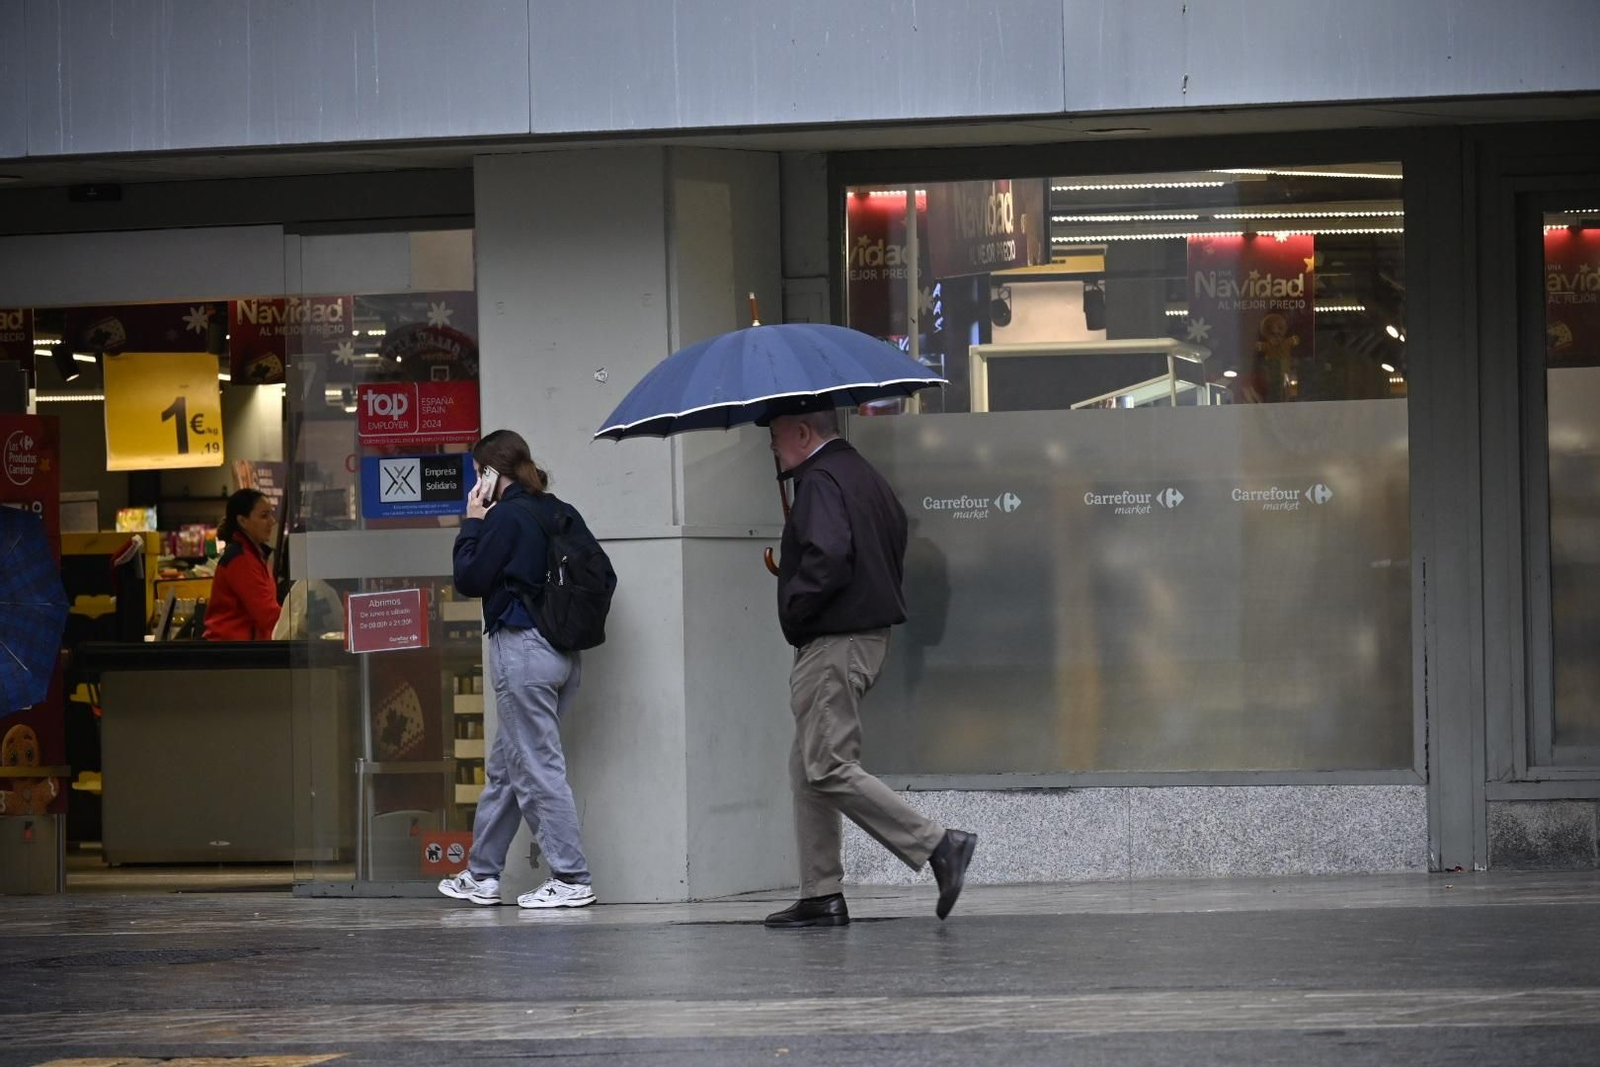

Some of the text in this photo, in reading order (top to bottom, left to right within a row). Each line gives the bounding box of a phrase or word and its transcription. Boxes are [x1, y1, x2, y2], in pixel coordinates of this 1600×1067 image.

[882, 269, 922, 279] PRECO
[1194, 270, 1304, 298] Navidad
[1217, 300, 1306, 310] AL MEJOR PRECIO
[236, 298, 344, 325] Navidad
[259, 327, 272, 336] AL
[363, 389, 408, 420] top
[421, 395, 454, 406] ESPAÑA
[422, 405, 446, 415] SPAIN
[367, 420, 409, 430] EMPLOYER
[422, 419, 442, 428] 2024
[425, 467, 457, 477] Empresa
[426, 481, 457, 490] Solidaria
[1083, 492, 1151, 506] Carrefour
[1231, 487, 1300, 502] Carrefour
[923, 496, 989, 510] Carrefour
[1262, 500, 1300, 512] market
[953, 508, 989, 520] market
[1114, 503, 1151, 515] market
[368, 599, 401, 607] Abrimos
